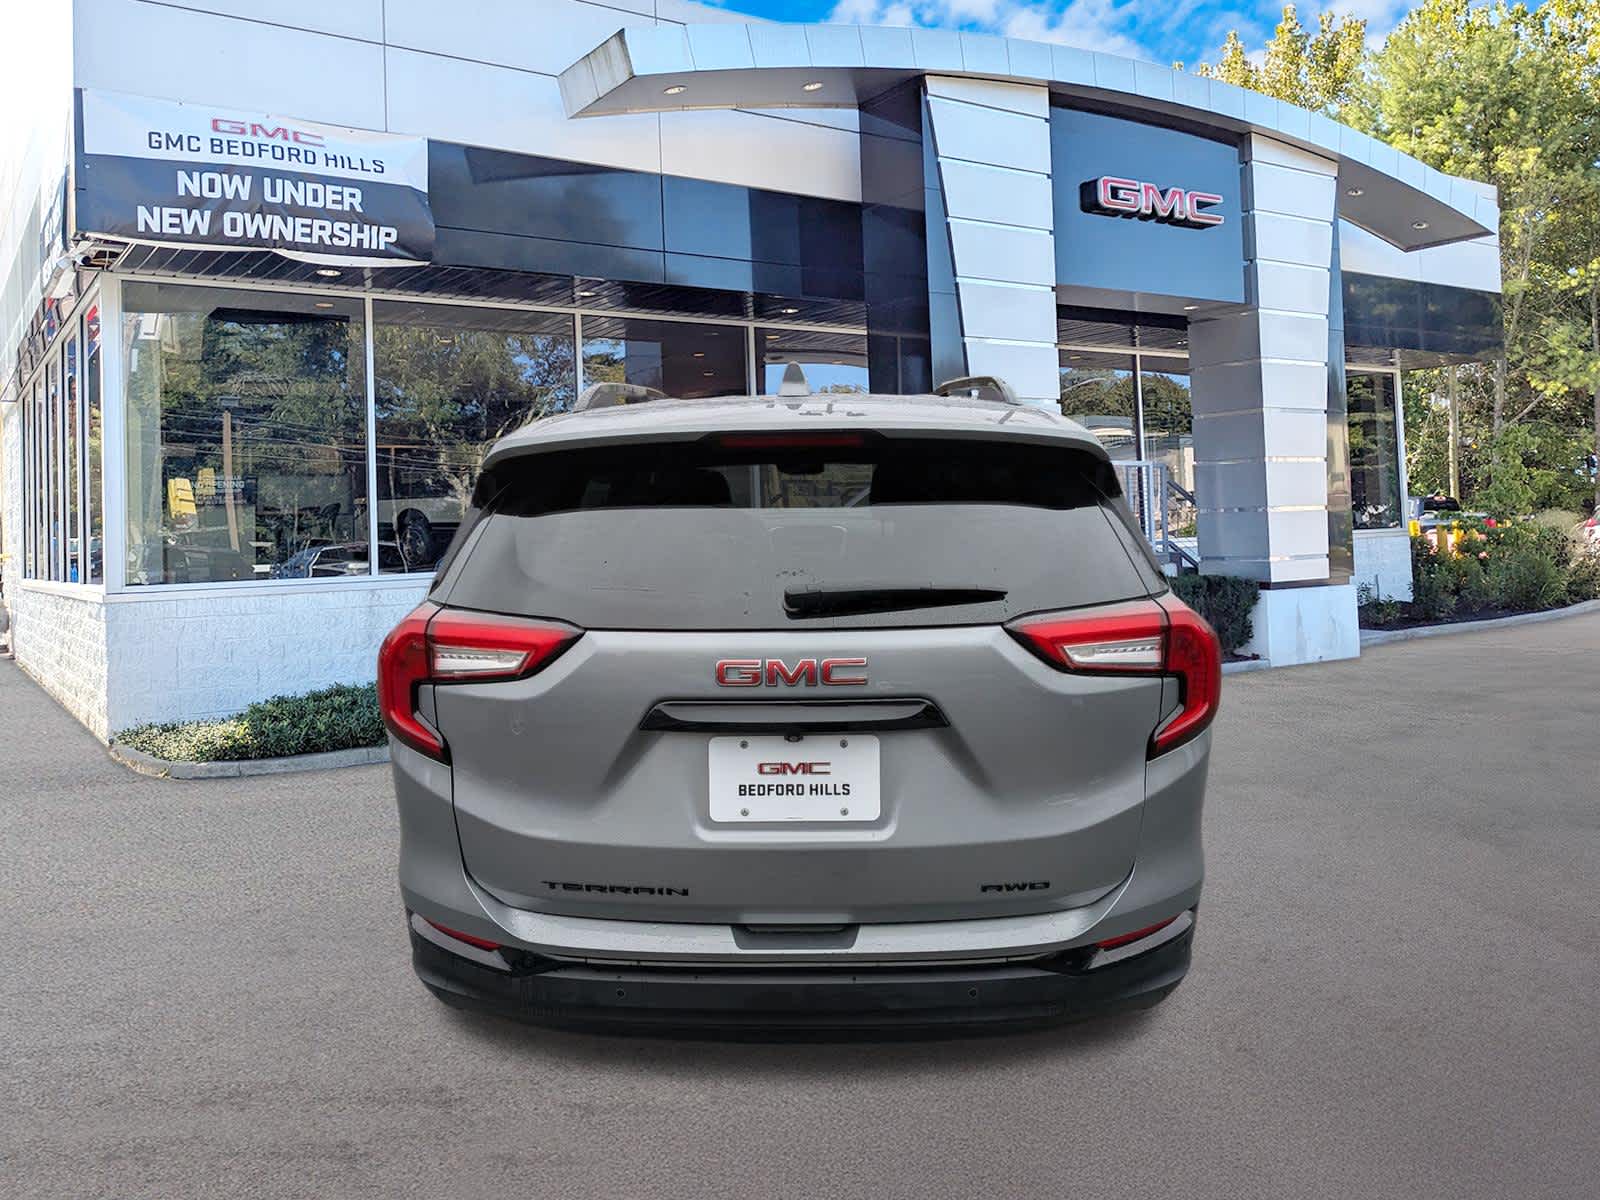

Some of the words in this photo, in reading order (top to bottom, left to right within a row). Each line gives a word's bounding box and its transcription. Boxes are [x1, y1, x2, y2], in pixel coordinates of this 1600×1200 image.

[210, 117, 326, 148] GMC
[148, 131, 201, 152] GMC
[210, 138, 317, 166] BEDFORD
[325, 153, 385, 174] HILLS
[176, 170, 252, 201] NOW
[263, 175, 364, 213] UNDER
[1097, 175, 1225, 225] GMC
[136, 205, 211, 236] NEW
[223, 210, 398, 250] OWNERSHIP
[715, 657, 868, 687] GMC
[757, 761, 831, 775] GMC
[738, 783, 805, 797] BEDFORD
[809, 783, 851, 796] HILLS
[541, 880, 689, 897] TERRAIN
[981, 882, 1050, 892] AWD
